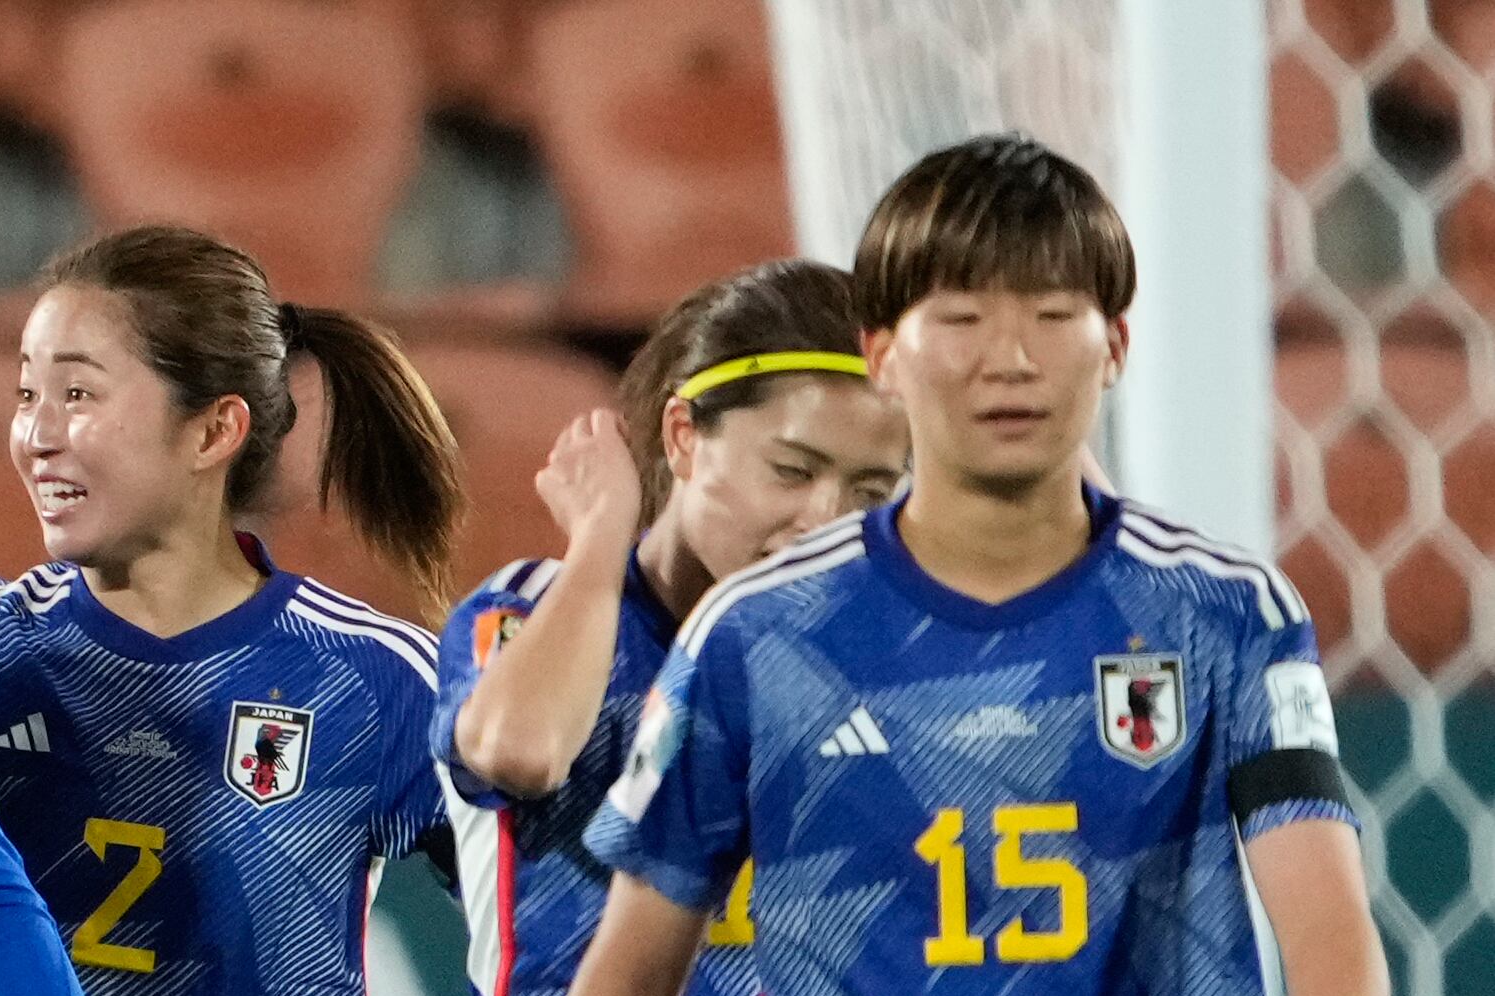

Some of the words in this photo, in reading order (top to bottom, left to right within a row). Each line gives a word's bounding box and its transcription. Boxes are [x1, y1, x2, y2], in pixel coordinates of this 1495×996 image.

[251, 707, 294, 721] JAPAN
[71, 818, 166, 973] 2
[914, 802, 1089, 967] 15
